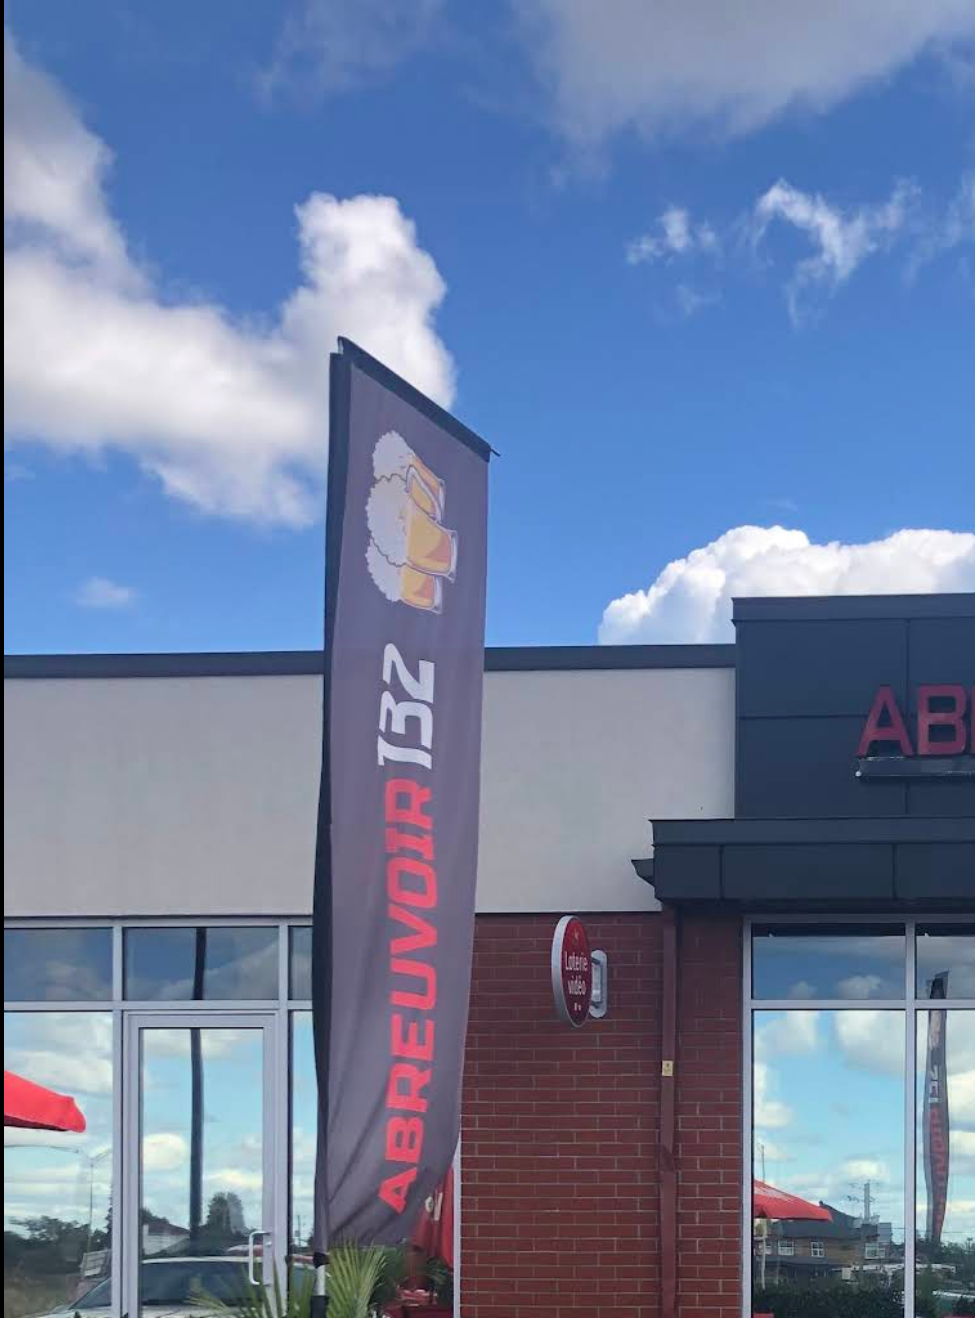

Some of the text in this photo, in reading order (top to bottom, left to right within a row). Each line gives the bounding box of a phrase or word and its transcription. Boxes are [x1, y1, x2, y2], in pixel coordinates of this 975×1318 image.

[377, 643, 438, 1215] ABREUVOIR 132
[564, 951, 589, 971] Loterie
